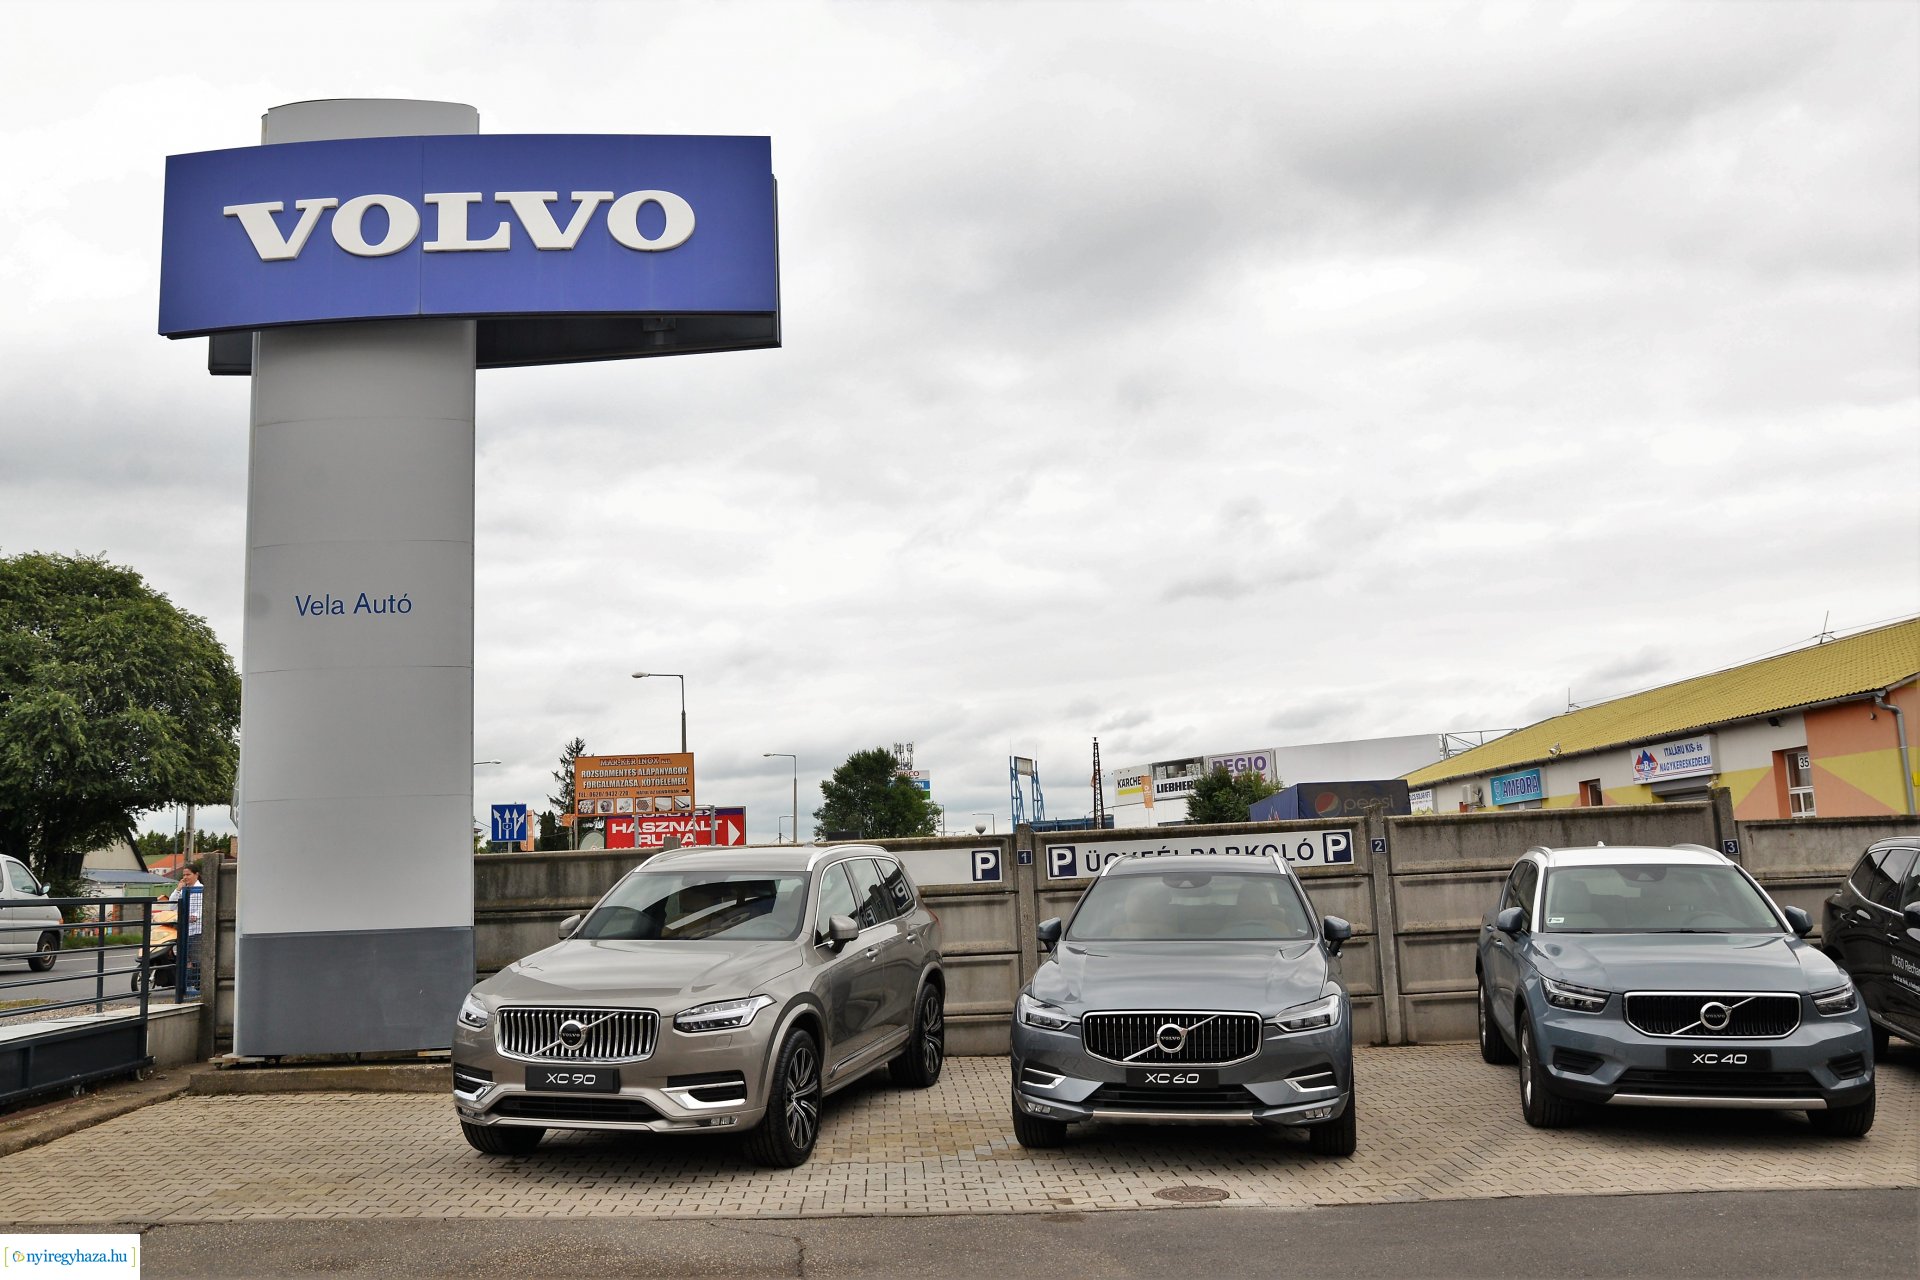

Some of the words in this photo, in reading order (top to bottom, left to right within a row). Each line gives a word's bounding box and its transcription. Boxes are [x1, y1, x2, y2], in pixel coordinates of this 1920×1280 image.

[223, 189, 696, 261] VOLVO
[295, 594, 345, 616] Vela
[353, 592, 412, 614] Autó
[1696, 742, 1703, 752] és
[638, 757, 660, 765] INOX
[1659, 755, 1711, 772] NAGYKERESKEDELEM
[1799, 757, 1810, 768] 35
[581, 768, 637, 778] ROZSDAMENTES
[638, 766, 689, 776] ALAPANYAGOK
[1502, 774, 1540, 798] AMFORA
[611, 818, 722, 834] HASZNÁLT
[639, 832, 697, 845] RUA
[1326, 833, 1347, 862] P
[1374, 841, 1384, 852] 2
[1727, 841, 1736, 853] 3
[1021, 853, 1028, 863] 1
[1052, 848, 1073, 876] P
[974, 852, 996, 880] P
